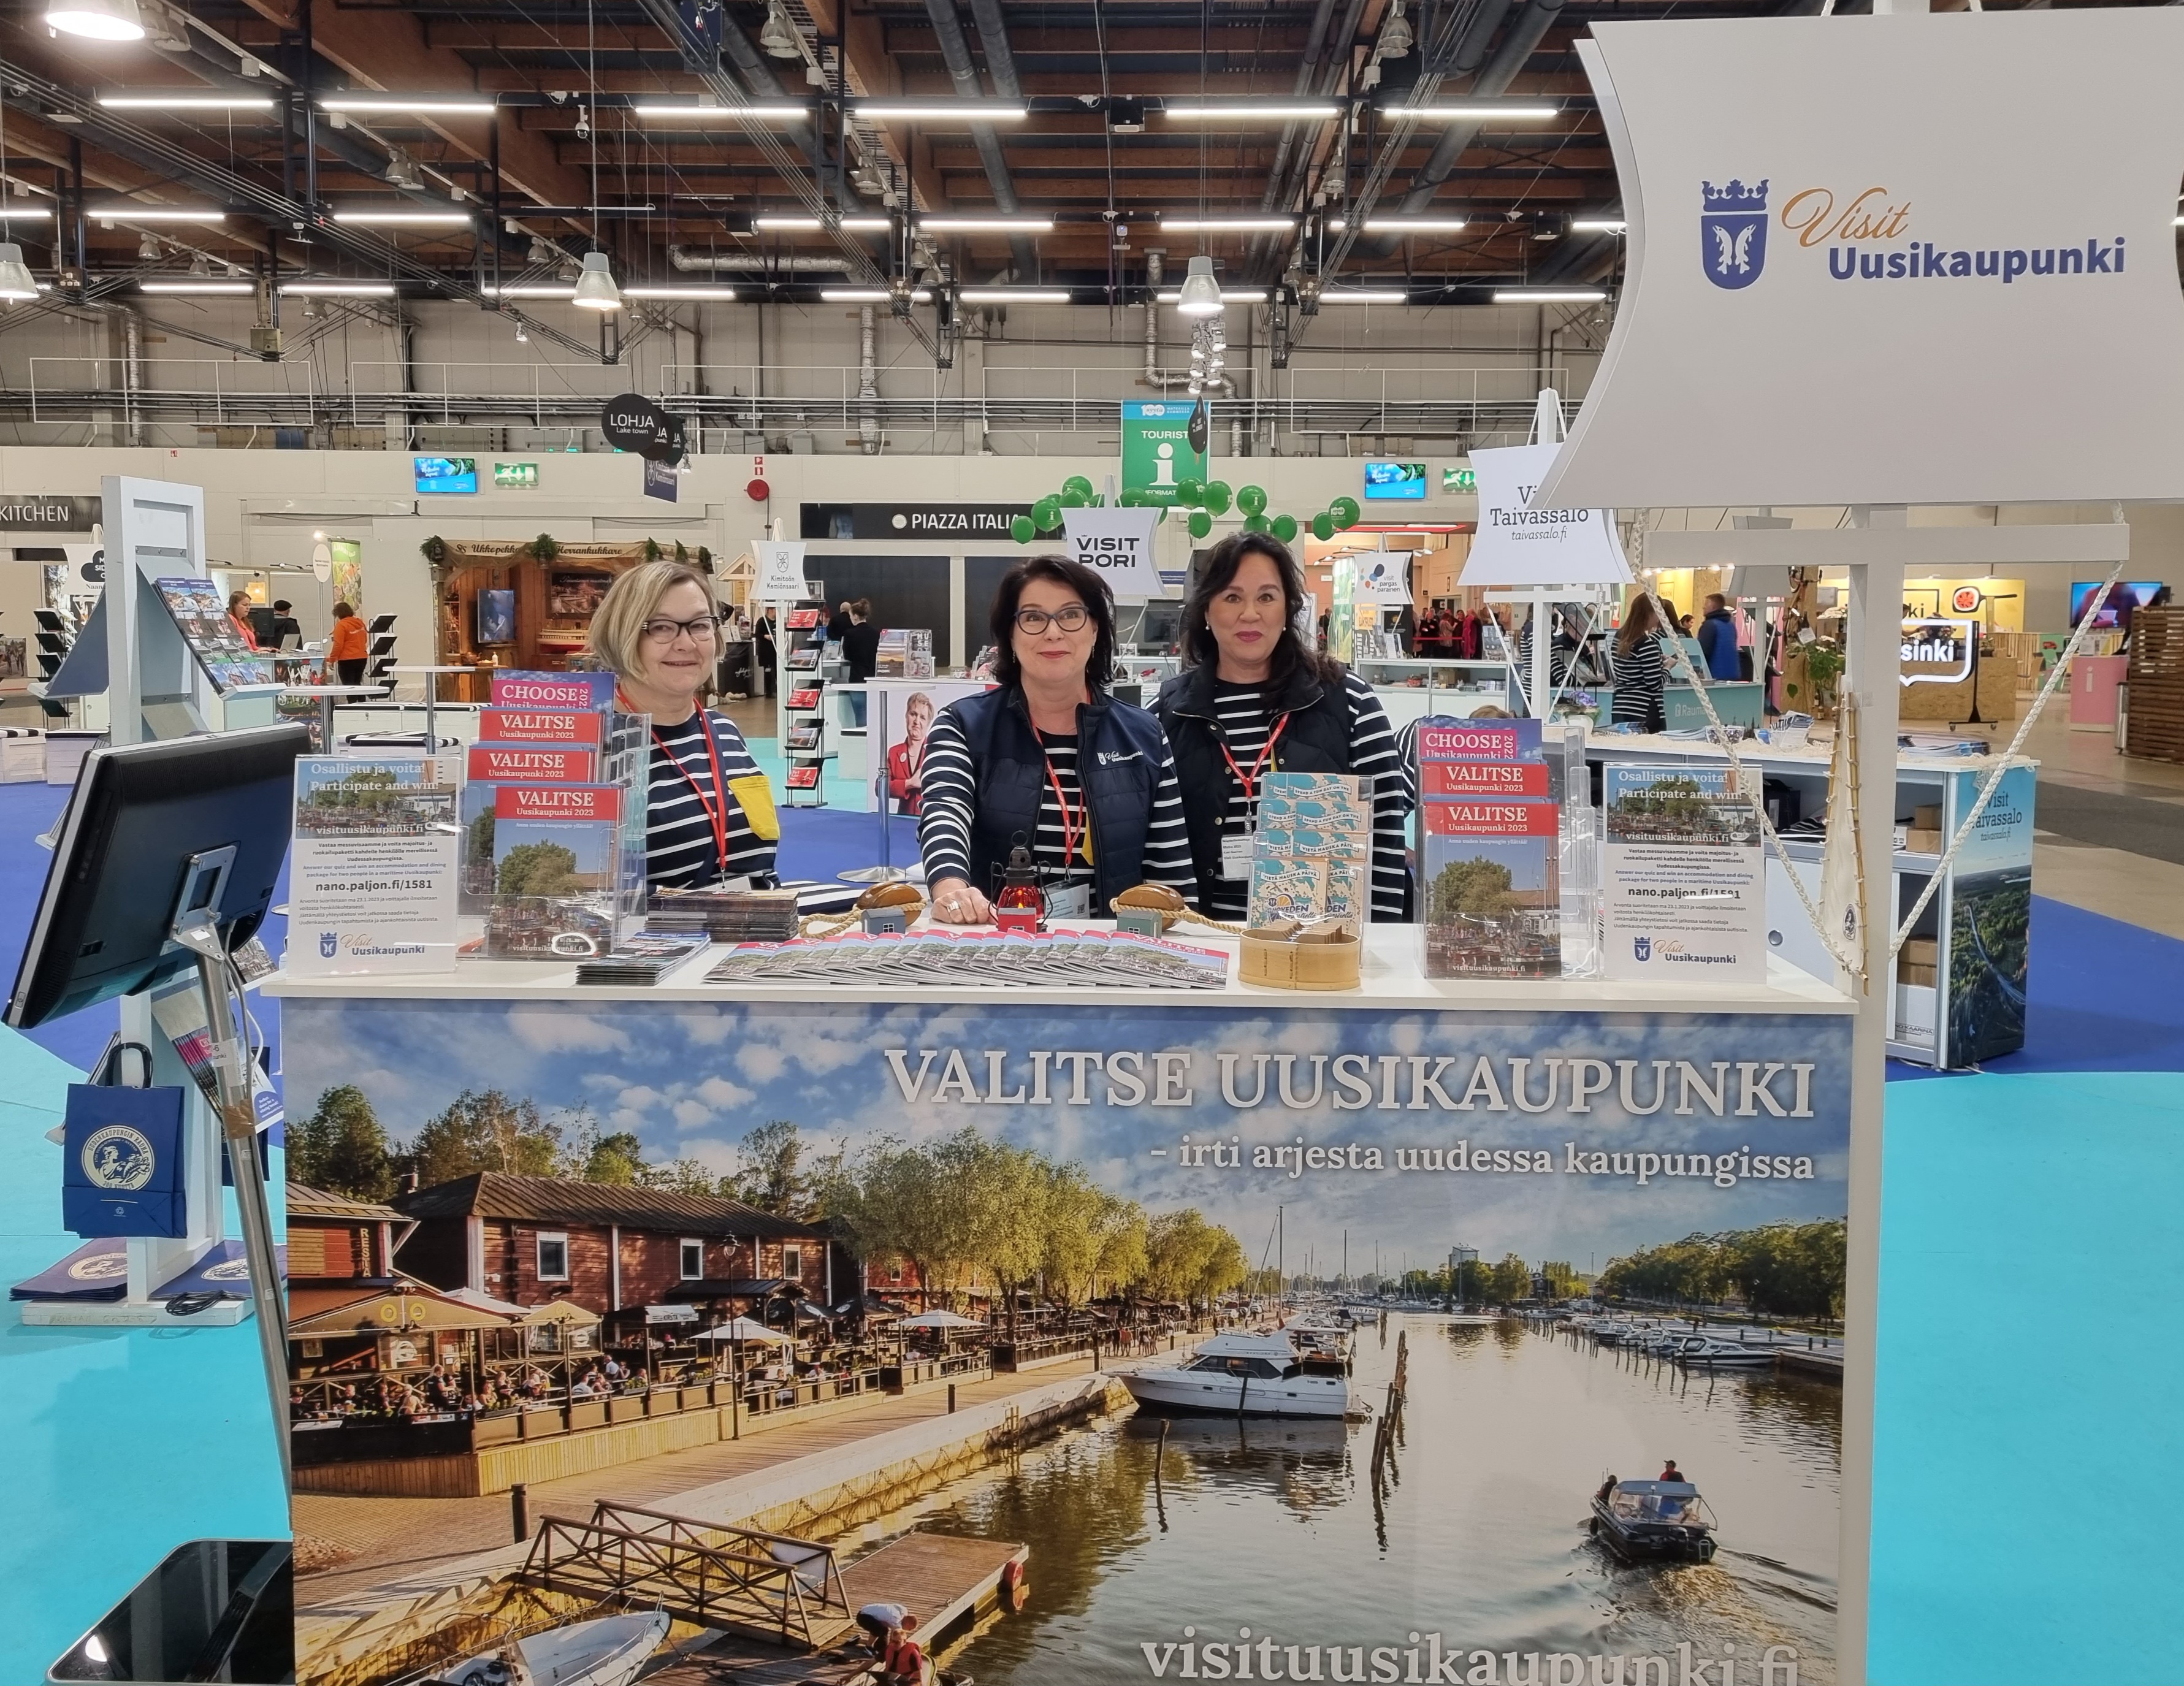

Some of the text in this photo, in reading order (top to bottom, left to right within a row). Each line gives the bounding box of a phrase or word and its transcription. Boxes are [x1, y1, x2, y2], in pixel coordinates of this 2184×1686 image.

[1781, 187, 1912, 248] Visit
[1828, 237, 2126, 283] Uusikaupunki
[610, 413, 654, 428] LOHJA
[0, 505, 69, 522] KITCHEN
[1490, 507, 1589, 527] Taivassalo
[912, 514, 968, 529] PIAZZA
[1511, 526, 1568, 543] taivassalo.fi
[1075, 537, 1140, 551] VISIT
[1079, 554, 1136, 568] PORI
[502, 685, 577, 701] CHOOSE
[500, 714, 575, 730] VALITSE
[500, 731, 554, 739] Uusikaupunki
[1426, 733, 1502, 749] CHOOSE
[489, 753, 565, 768] VALITSE
[311, 763, 426, 776] Osallistu ja voita!
[489, 769, 544, 778] Uusikaupunki
[1446, 766, 1523, 782] VALITSE
[1619, 771, 1728, 785] Osallistu ja voita!
[311, 779, 438, 793] Participate and win!
[1446, 783, 1502, 793] Uusikaupunki
[517, 792, 594, 806] VALITSE
[1619, 788, 1742, 801] Participate and win!
[516, 808, 572, 817] Uusikaupunki
[1448, 806, 1527, 822] VALITSE
[1972, 807, 2022, 829] aivassalo
[316, 824, 423, 835] visituusikaupunki.fi
[1448, 823, 1506, 833] Uusikaupunki
[1625, 832, 1729, 843] visituusikaupunki.fi
[316, 879, 432, 892] nano.paljon.fi/1581
[340, 934, 373, 948] Visit
[1654, 939, 1685, 953] Visit
[352, 945, 425, 956] Uusikaupunki
[1665, 953, 1736, 964] Uusikaupunki
[1453, 964, 1525, 973] visituusikaupunki.fi
[885, 1049, 1816, 1118] VALITSE UUSIKAUPUNKI
[1179, 1134, 1240, 1169] irti
[1253, 1136, 1384, 1179] arjesta
[1396, 1140, 1554, 1173] uudessa
[1565, 1142, 1814, 1187] kaupungissa
[1141, 1626, 1799, 1686] visituusikaupunkifi
